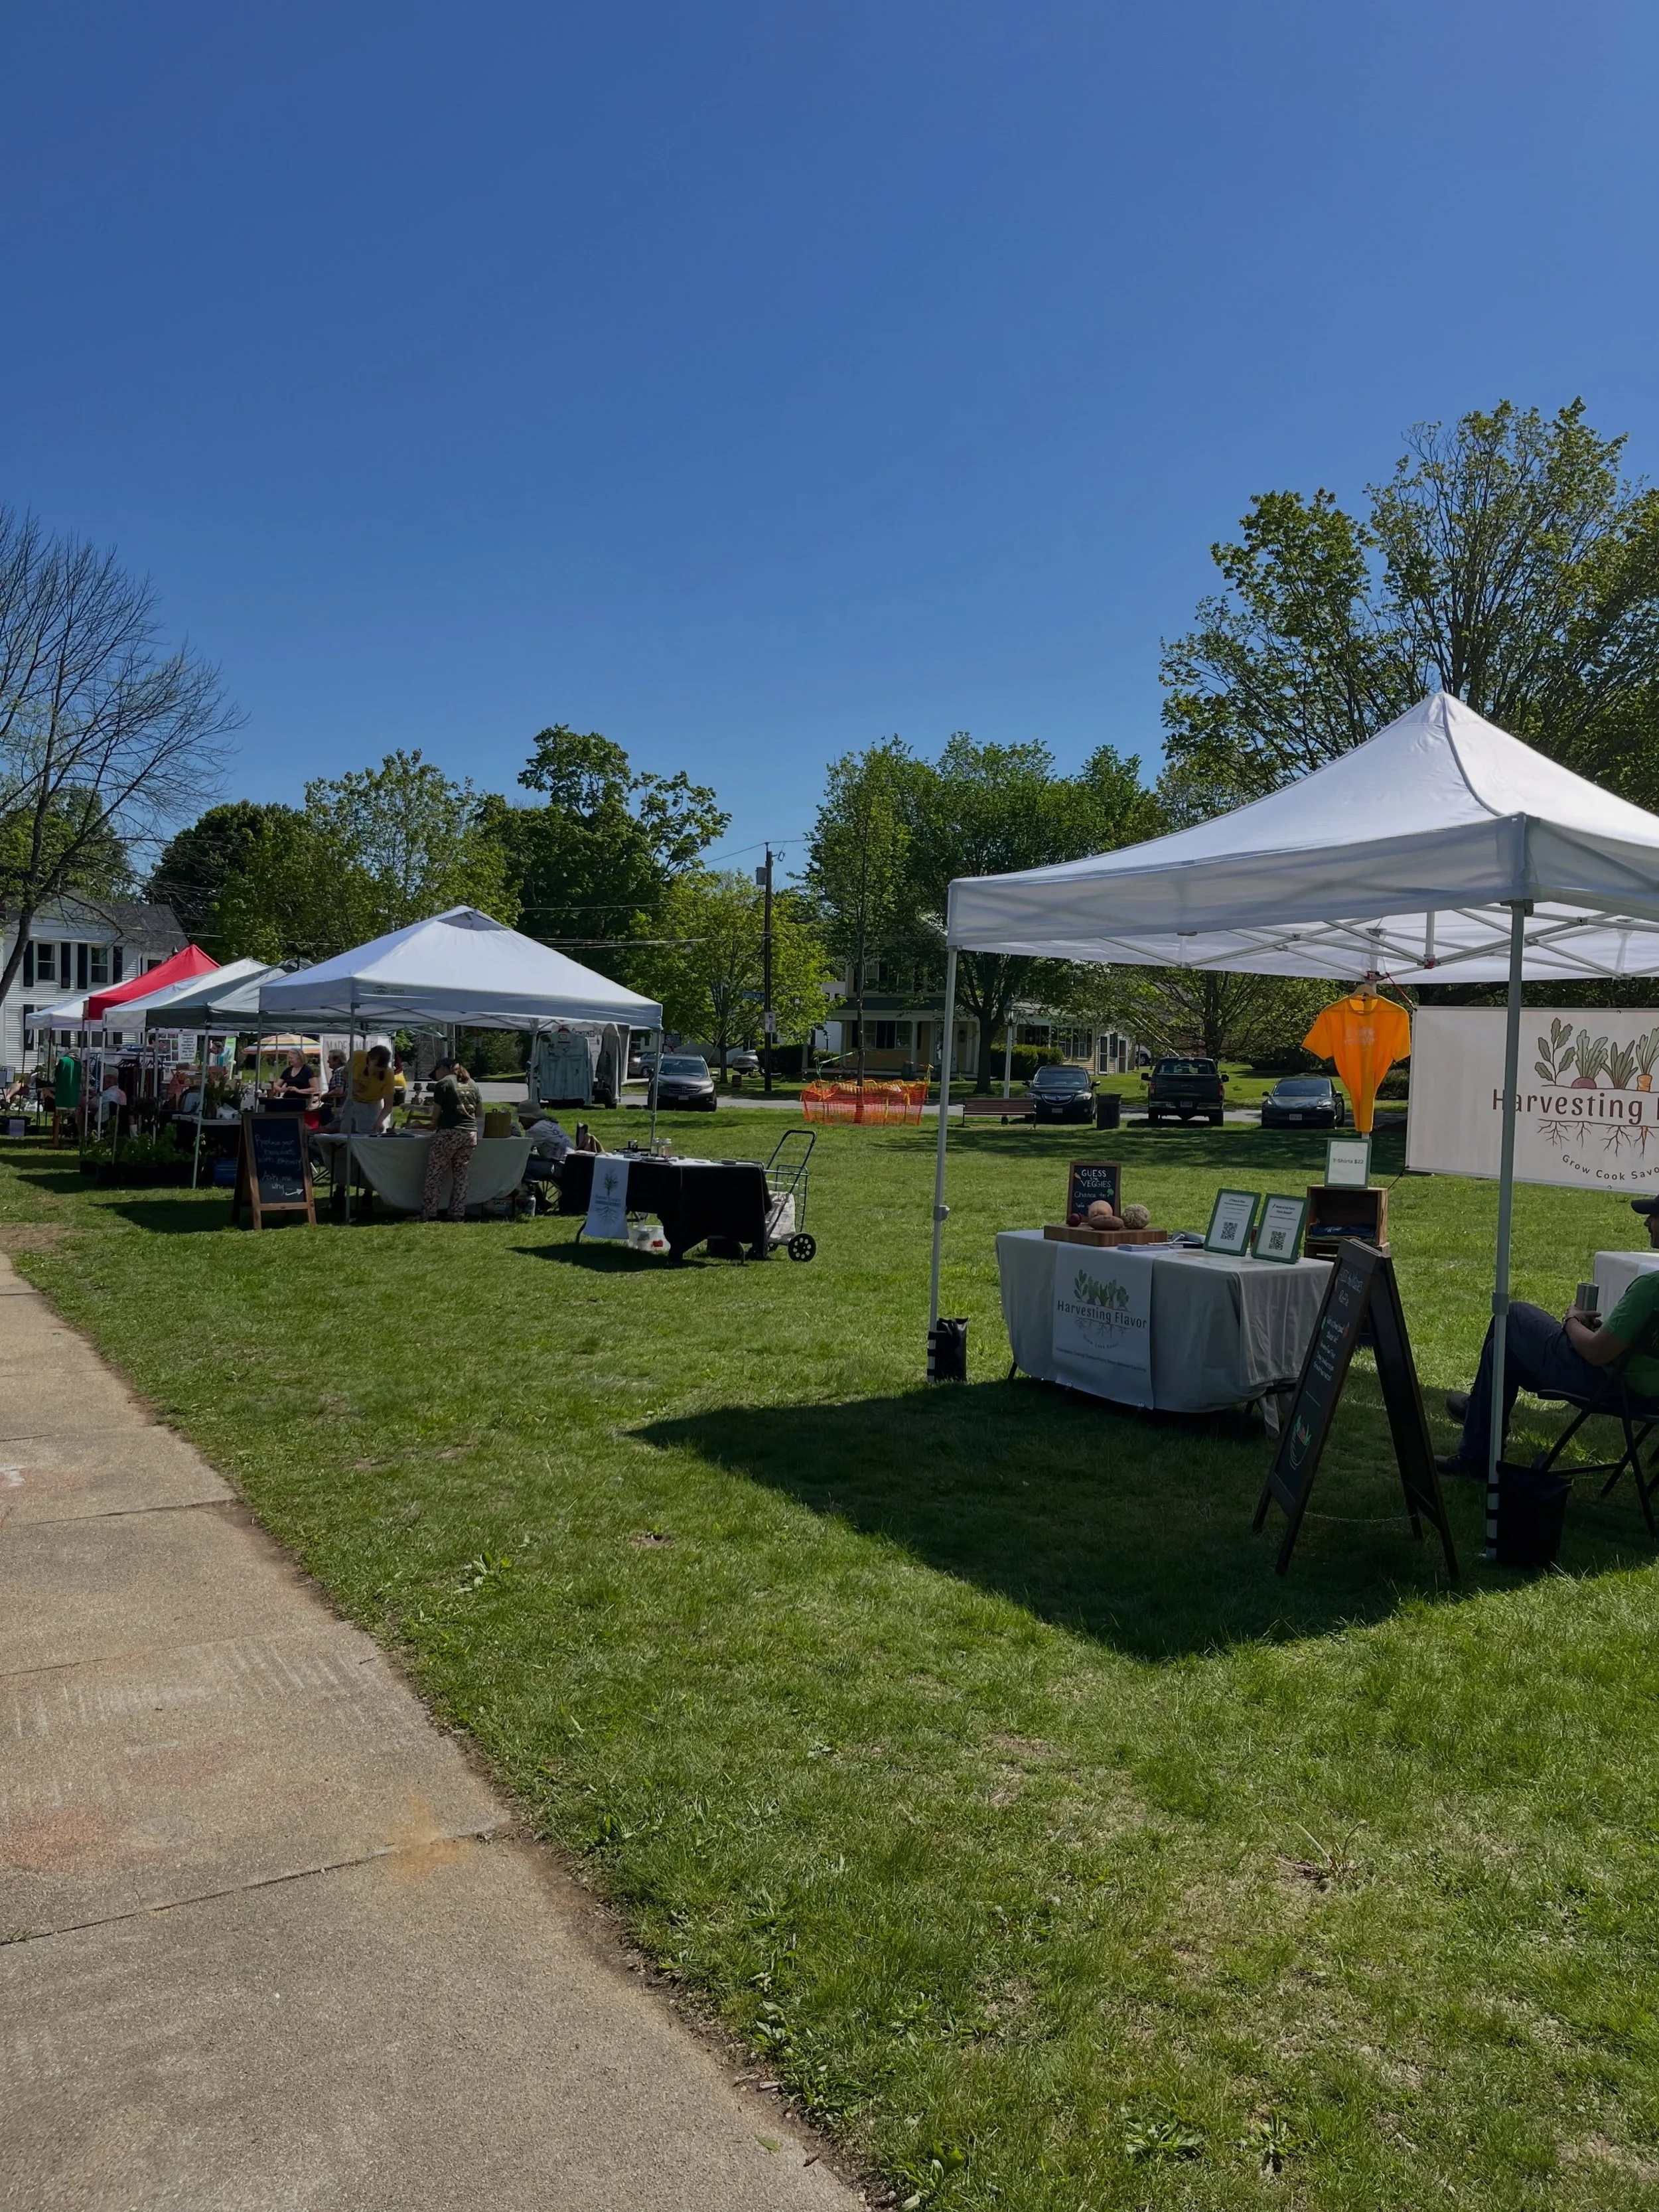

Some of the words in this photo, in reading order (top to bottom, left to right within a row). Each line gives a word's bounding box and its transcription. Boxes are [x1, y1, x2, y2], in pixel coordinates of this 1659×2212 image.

[1492, 1089, 1642, 1124] Harvesting
[1563, 1155, 1591, 1173] Grow
[1596, 1169, 1625, 1180] Cook
[1080, 1179, 1112, 1188] VEGGIES
[1057, 1300, 1111, 1324] Harvesting
[1115, 1312, 1147, 1329] Flavor
